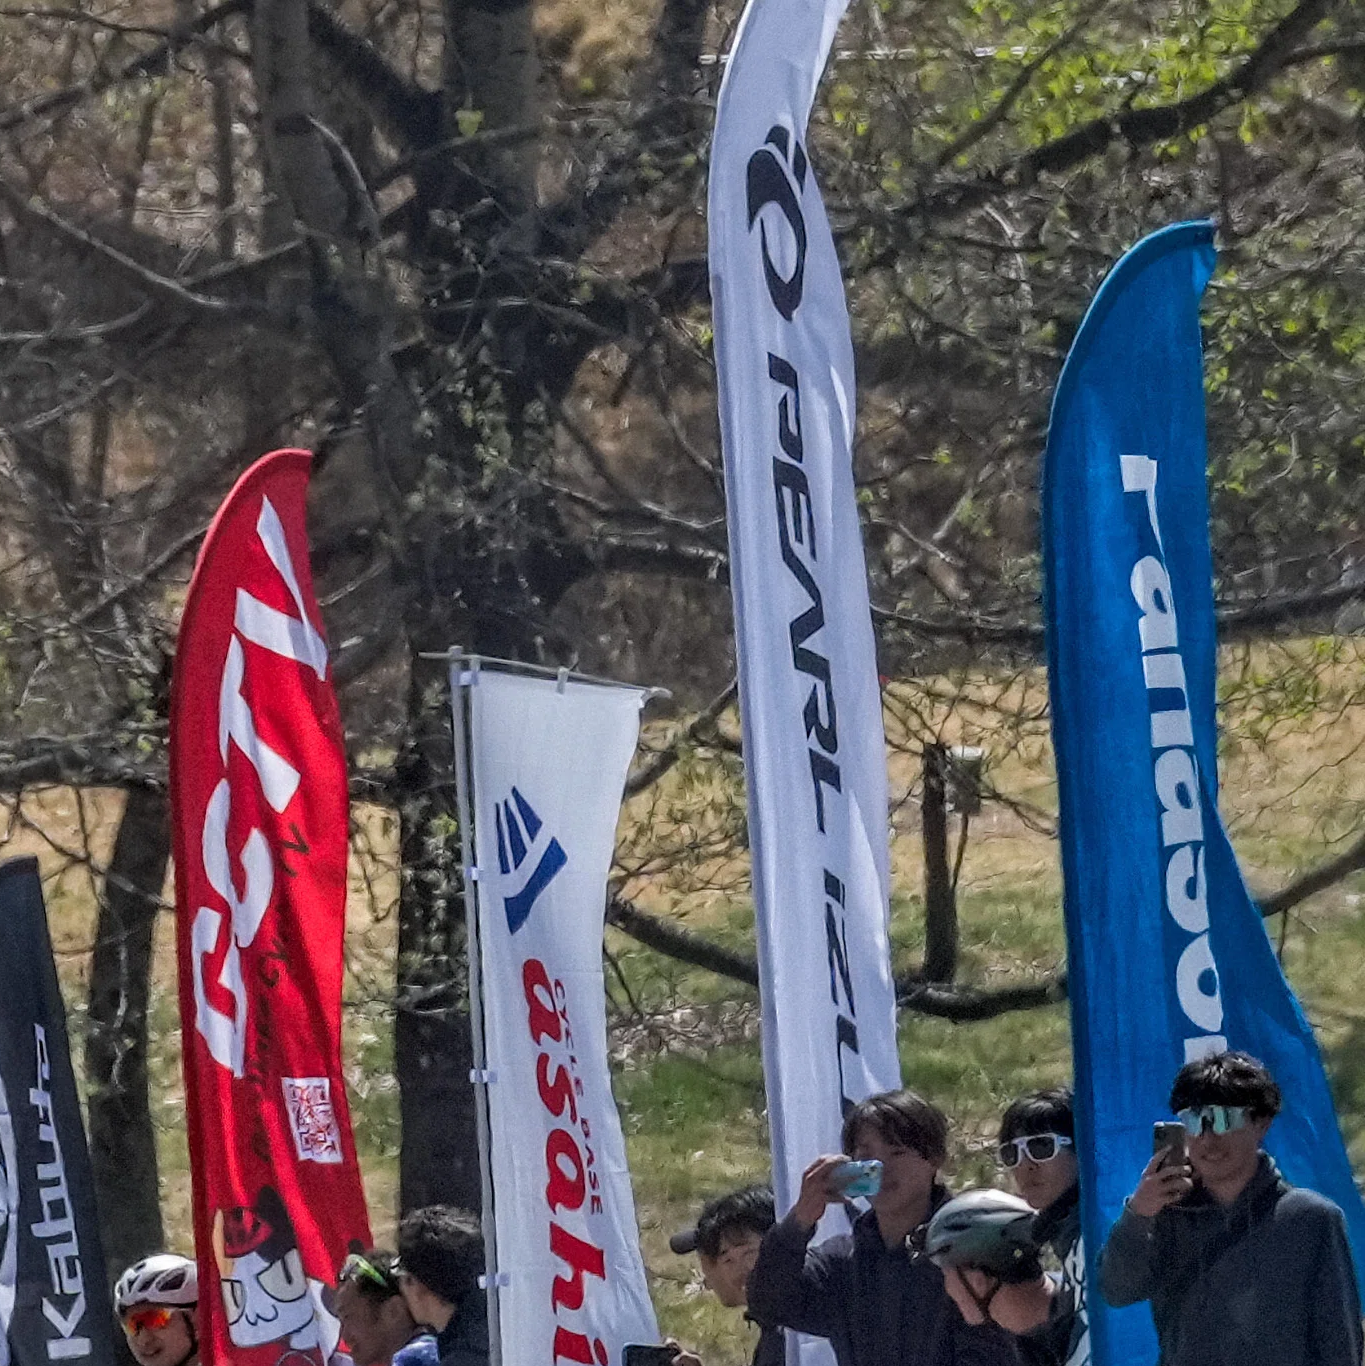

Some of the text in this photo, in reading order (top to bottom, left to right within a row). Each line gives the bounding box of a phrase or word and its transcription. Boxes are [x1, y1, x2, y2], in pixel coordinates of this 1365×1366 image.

[767, 352, 843, 834] PEARL
[29, 1023, 93, 1361] Kabuto
[522, 958, 609, 1366] asahi
